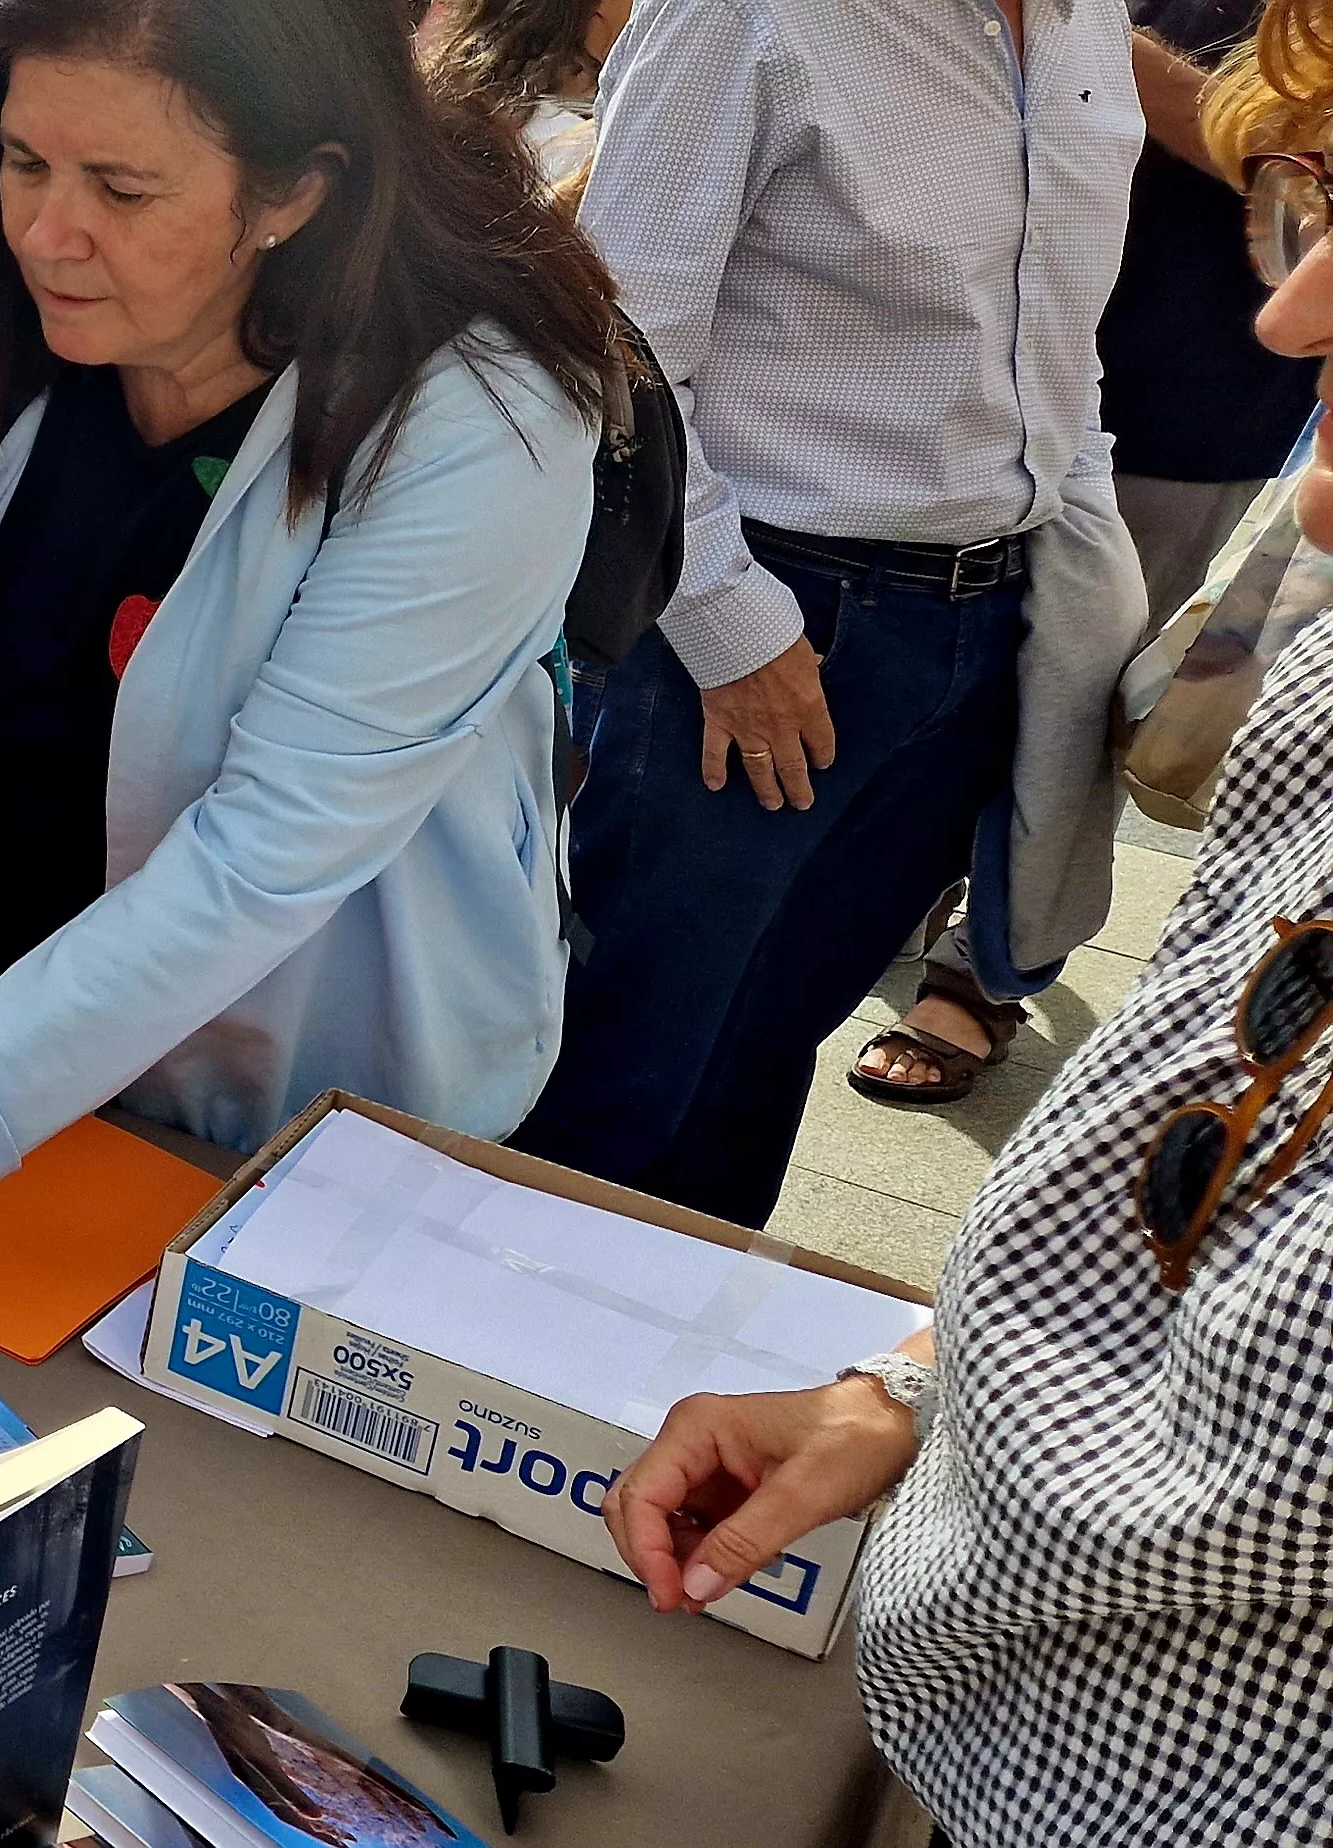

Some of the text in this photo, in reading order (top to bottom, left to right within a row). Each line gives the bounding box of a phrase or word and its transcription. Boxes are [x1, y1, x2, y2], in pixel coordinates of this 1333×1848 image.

[187, 1298, 215, 1315] mm
[218, 1312, 245, 1329] 297
[258, 1329, 285, 1345] 210
[182, 1318, 284, 1391] A4
[333, 1345, 415, 1391] 5x500
[458, 1399, 543, 1440] suzano
